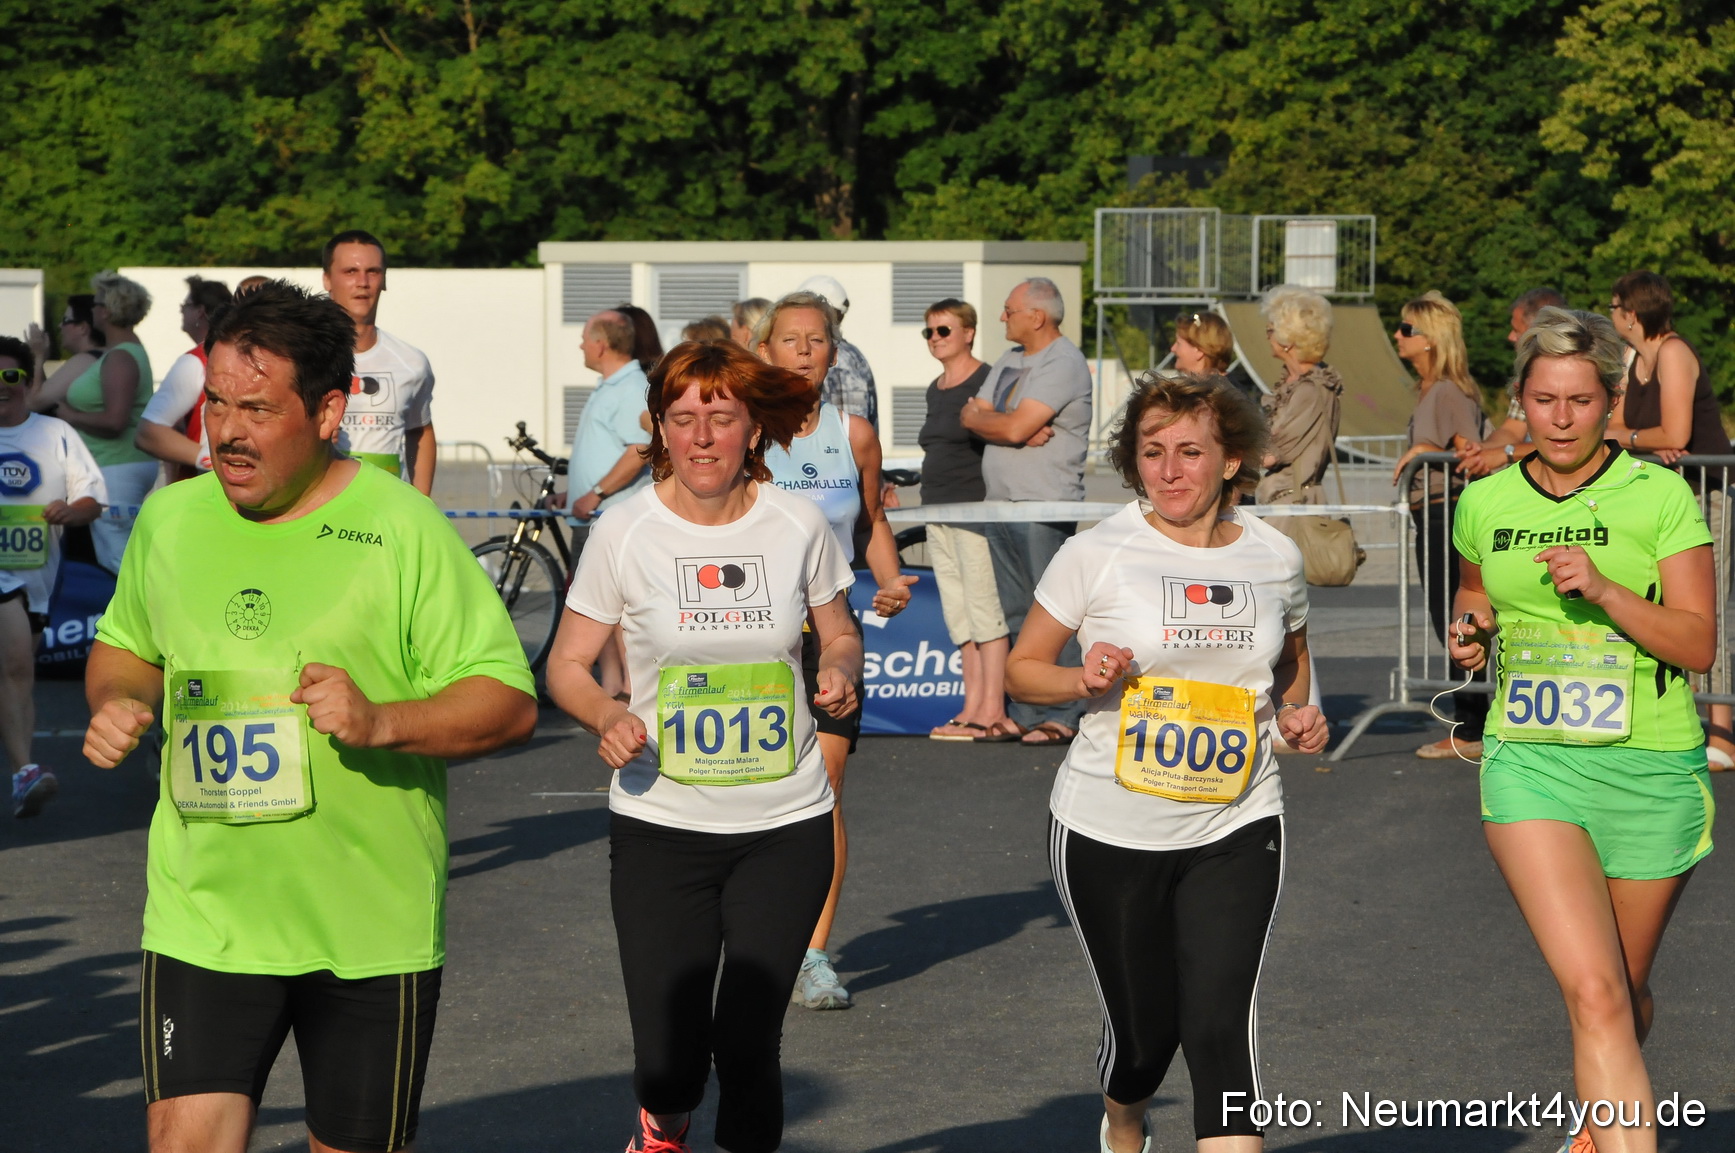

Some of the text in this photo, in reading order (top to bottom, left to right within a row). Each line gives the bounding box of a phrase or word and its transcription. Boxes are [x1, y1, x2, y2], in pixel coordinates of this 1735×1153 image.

[771, 479, 852, 490] CHABMÜLLER
[337, 528, 383, 547] DEKRA
[1514, 525, 1609, 547] Freitag
[679, 610, 774, 624] POLGER
[678, 623, 775, 631] TRANSPORT
[1162, 629, 1255, 643] POLGER
[1511, 628, 1542, 640] 2014
[679, 685, 726, 695] firmenlauf
[727, 689, 752, 698] 2014
[221, 701, 248, 712] 2014
[1143, 698, 1192, 710] firmenlauf
[1506, 679, 1625, 729] 5032
[1129, 710, 1167, 722] walken
[664, 705, 788, 755] 1013
[1125, 719, 1248, 774] 1008
[183, 723, 280, 784] 195
[695, 758, 735, 766] Malgorzata
[689, 768, 710, 776] Polger
[712, 767, 744, 776] Transport
[1141, 767, 1224, 784] Alicja Pluta-Barczynska
[1143, 778, 1165, 787] Polger
[1166, 781, 1197, 792] Transport
[200, 787, 262, 797] Thorsten Goppel
[177, 797, 297, 809] DEKRA Automobil & Friends GmbH
